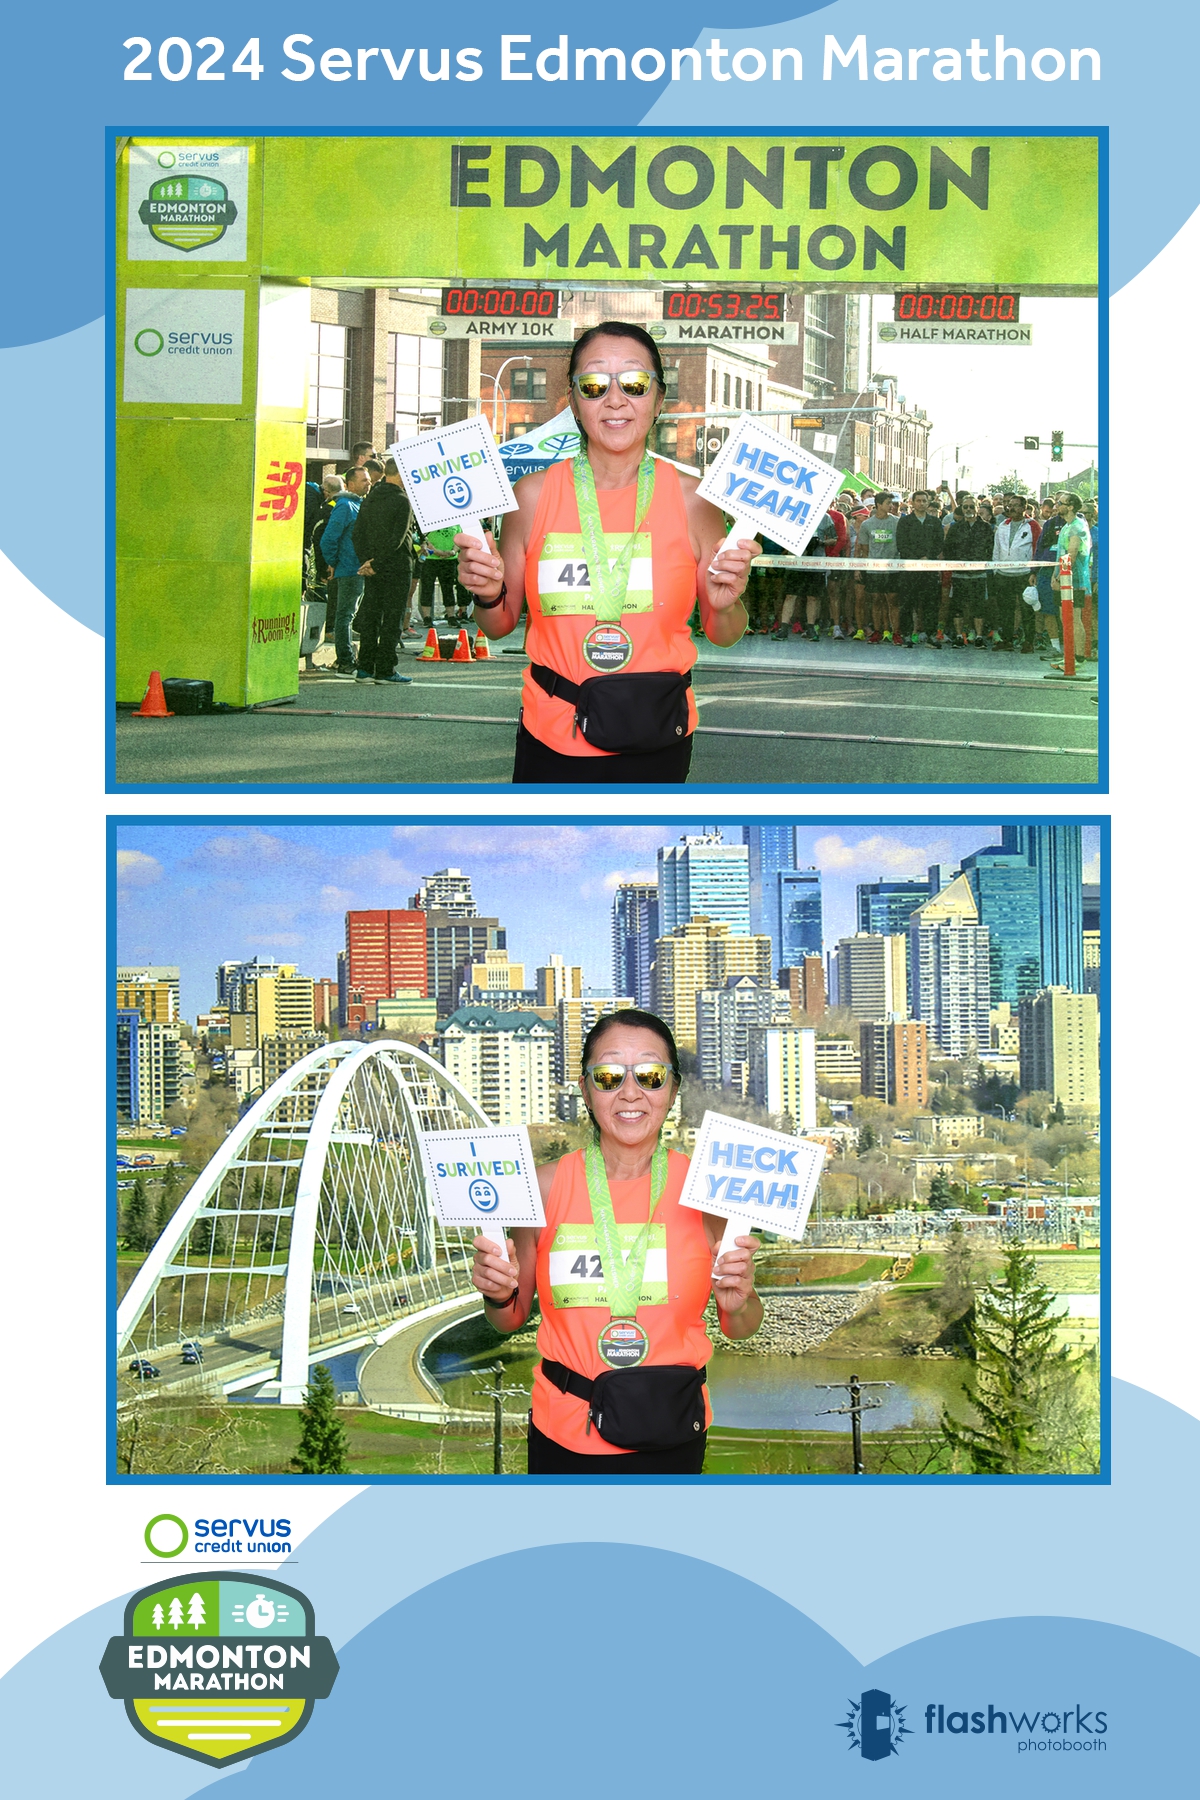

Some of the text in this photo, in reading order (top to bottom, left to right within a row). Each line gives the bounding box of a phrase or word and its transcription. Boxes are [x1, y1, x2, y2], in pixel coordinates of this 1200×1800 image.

[178, 152, 220, 161] servus
[449, 144, 991, 211] EDMONTON
[149, 203, 227, 214] EDMONTON
[160, 214, 215, 222] MARATHON
[523, 222, 907, 272] MARATHON
[465, 321, 555, 336] ARMY 10K
[678, 325, 785, 340] MARATHON
[900, 328, 1031, 341] HALF MARATHON
[168, 331, 233, 345] servus
[168, 345, 233, 355] credit union
[437, 441, 445, 456] I
[410, 449, 488, 484] SURVIVED!
[505, 465, 545, 475] ervus
[732, 442, 819, 496] HECK
[722, 472, 812, 526] YEAH!
[557, 563, 596, 587] 42
[470, 1142, 477, 1157] I
[708, 1141, 799, 1176] HECK
[436, 1160, 521, 1178] SURVIVED!
[705, 1174, 800, 1210] YEAH!
[570, 1254, 609, 1278] 42
